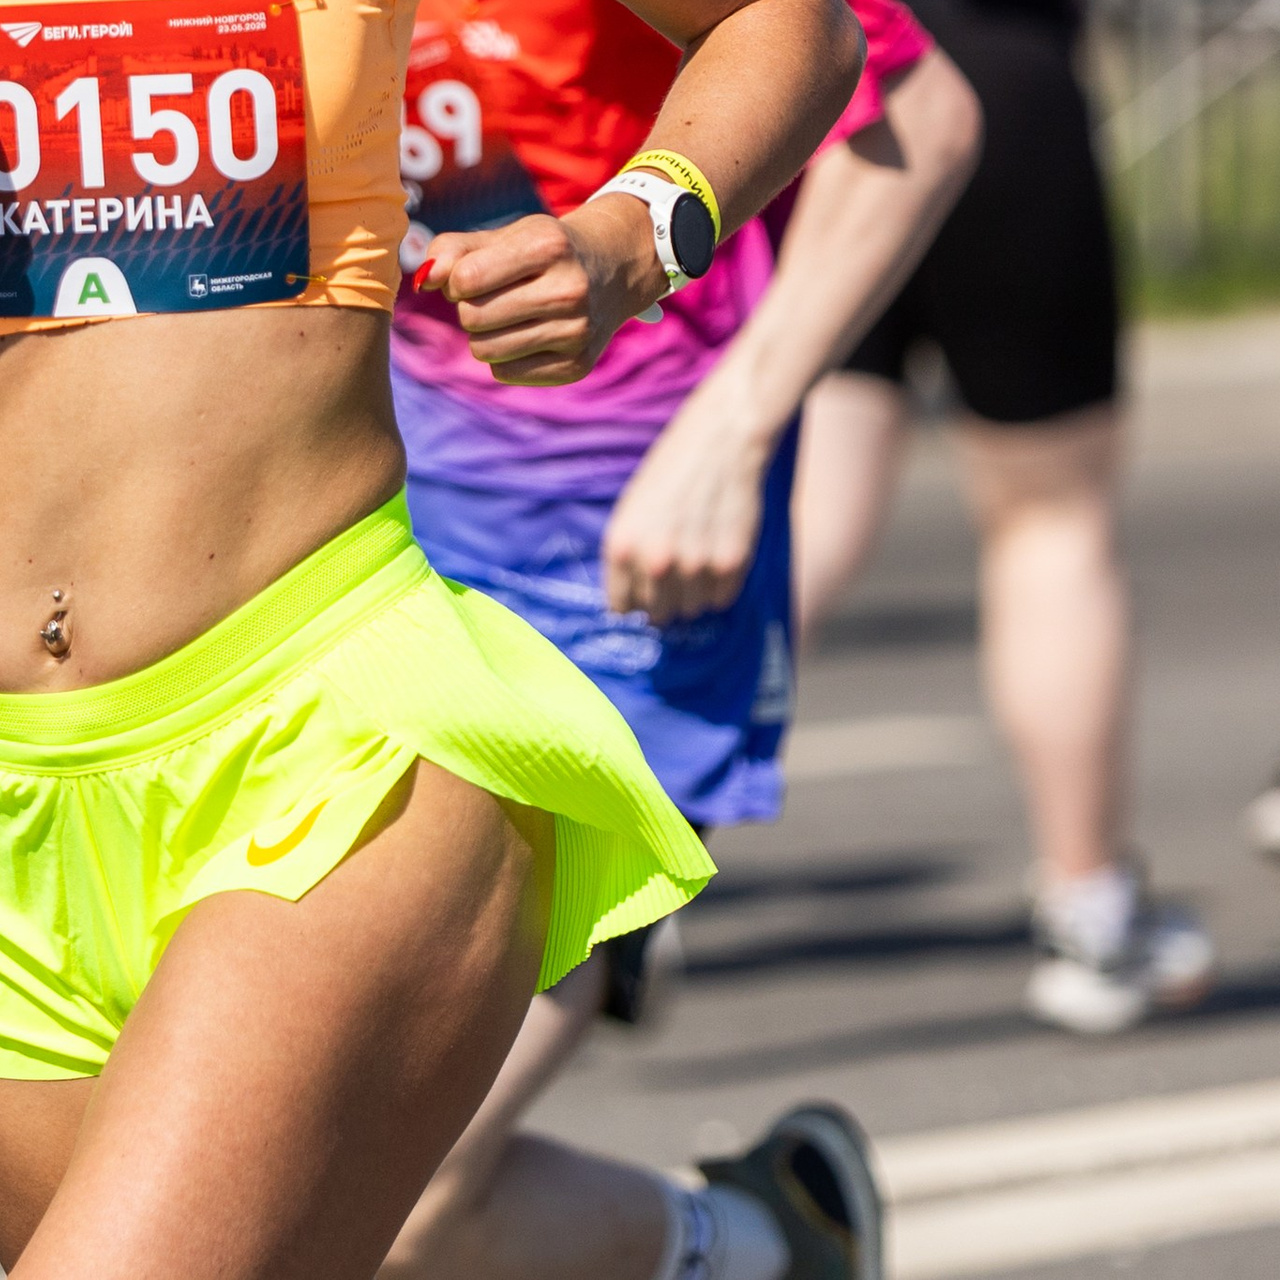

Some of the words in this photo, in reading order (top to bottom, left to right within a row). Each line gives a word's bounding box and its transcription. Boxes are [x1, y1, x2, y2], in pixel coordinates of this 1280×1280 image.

[168, 16, 213, 28] НИЖНИЙ
[214, 11, 266, 25] НОВГОРОД
[210, 272, 272, 285] НИЖЕГОРОДСКАЯ
[211, 283, 244, 292] ОБЛАСТЬ
